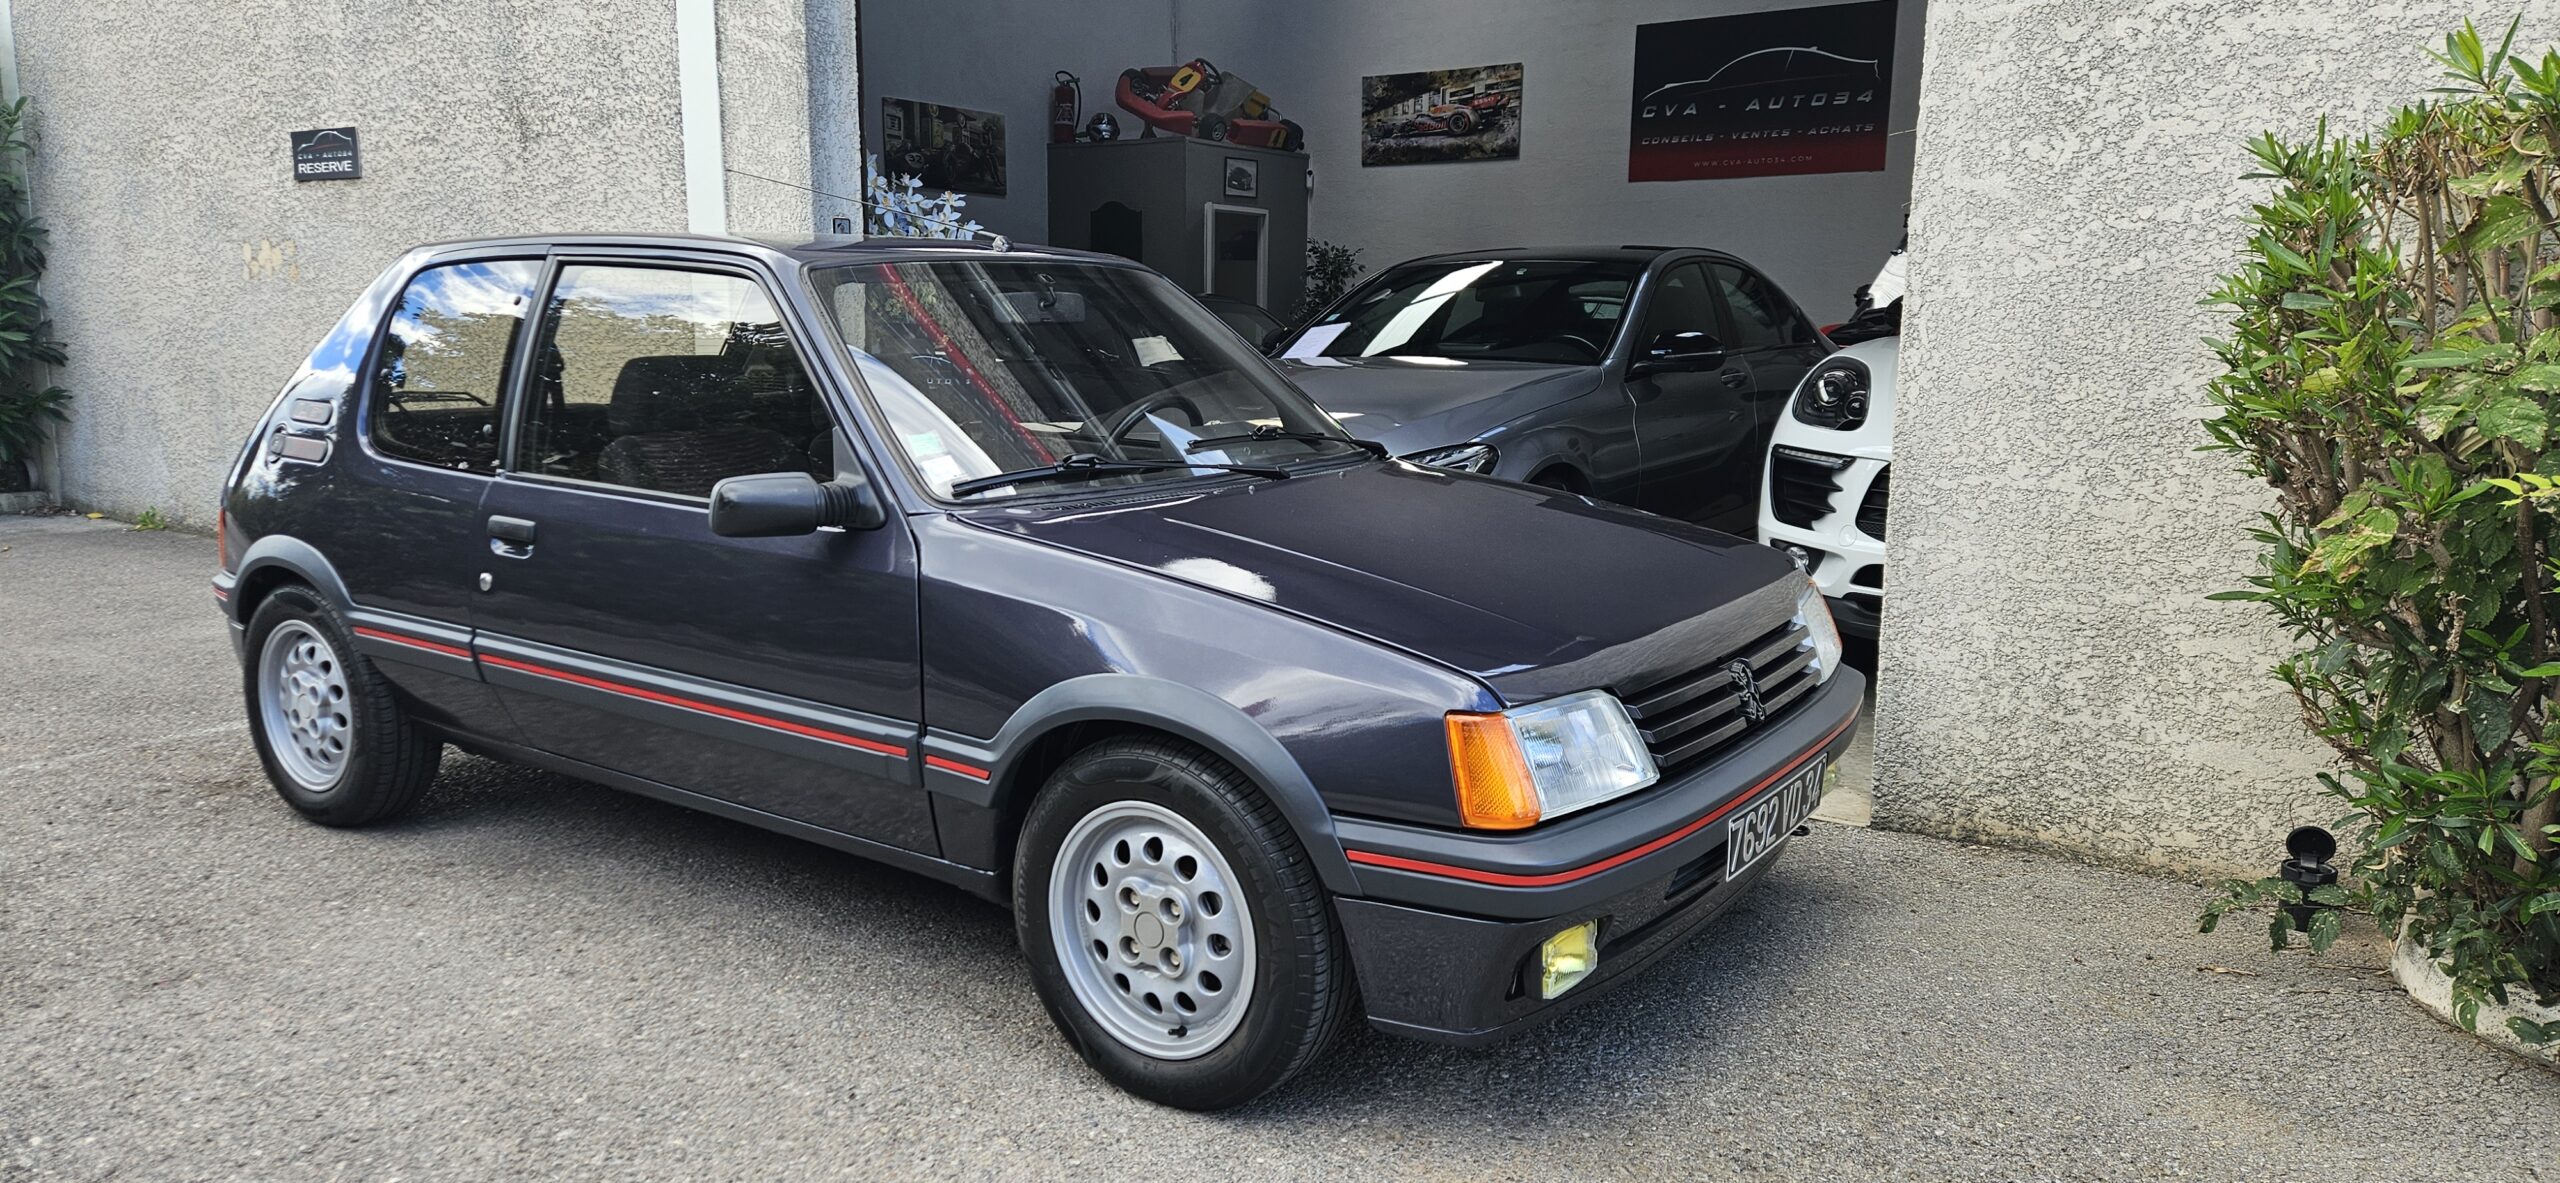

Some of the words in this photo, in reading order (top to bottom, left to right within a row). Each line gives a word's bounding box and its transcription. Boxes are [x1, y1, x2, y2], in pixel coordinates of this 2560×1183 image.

[1642, 102, 1698, 119] CVA
[1745, 89, 1874, 112] AUTO34
[1641, 133, 1714, 145] CONSEILS
[1732, 128, 1792, 140] VENTES
[1807, 123, 1876, 135] ACHATS
[298, 160, 353, 174] RESERVE
[1731, 796, 1779, 872] 7692
[1782, 779, 1803, 834] VD
[1802, 762, 1822, 816] 34
